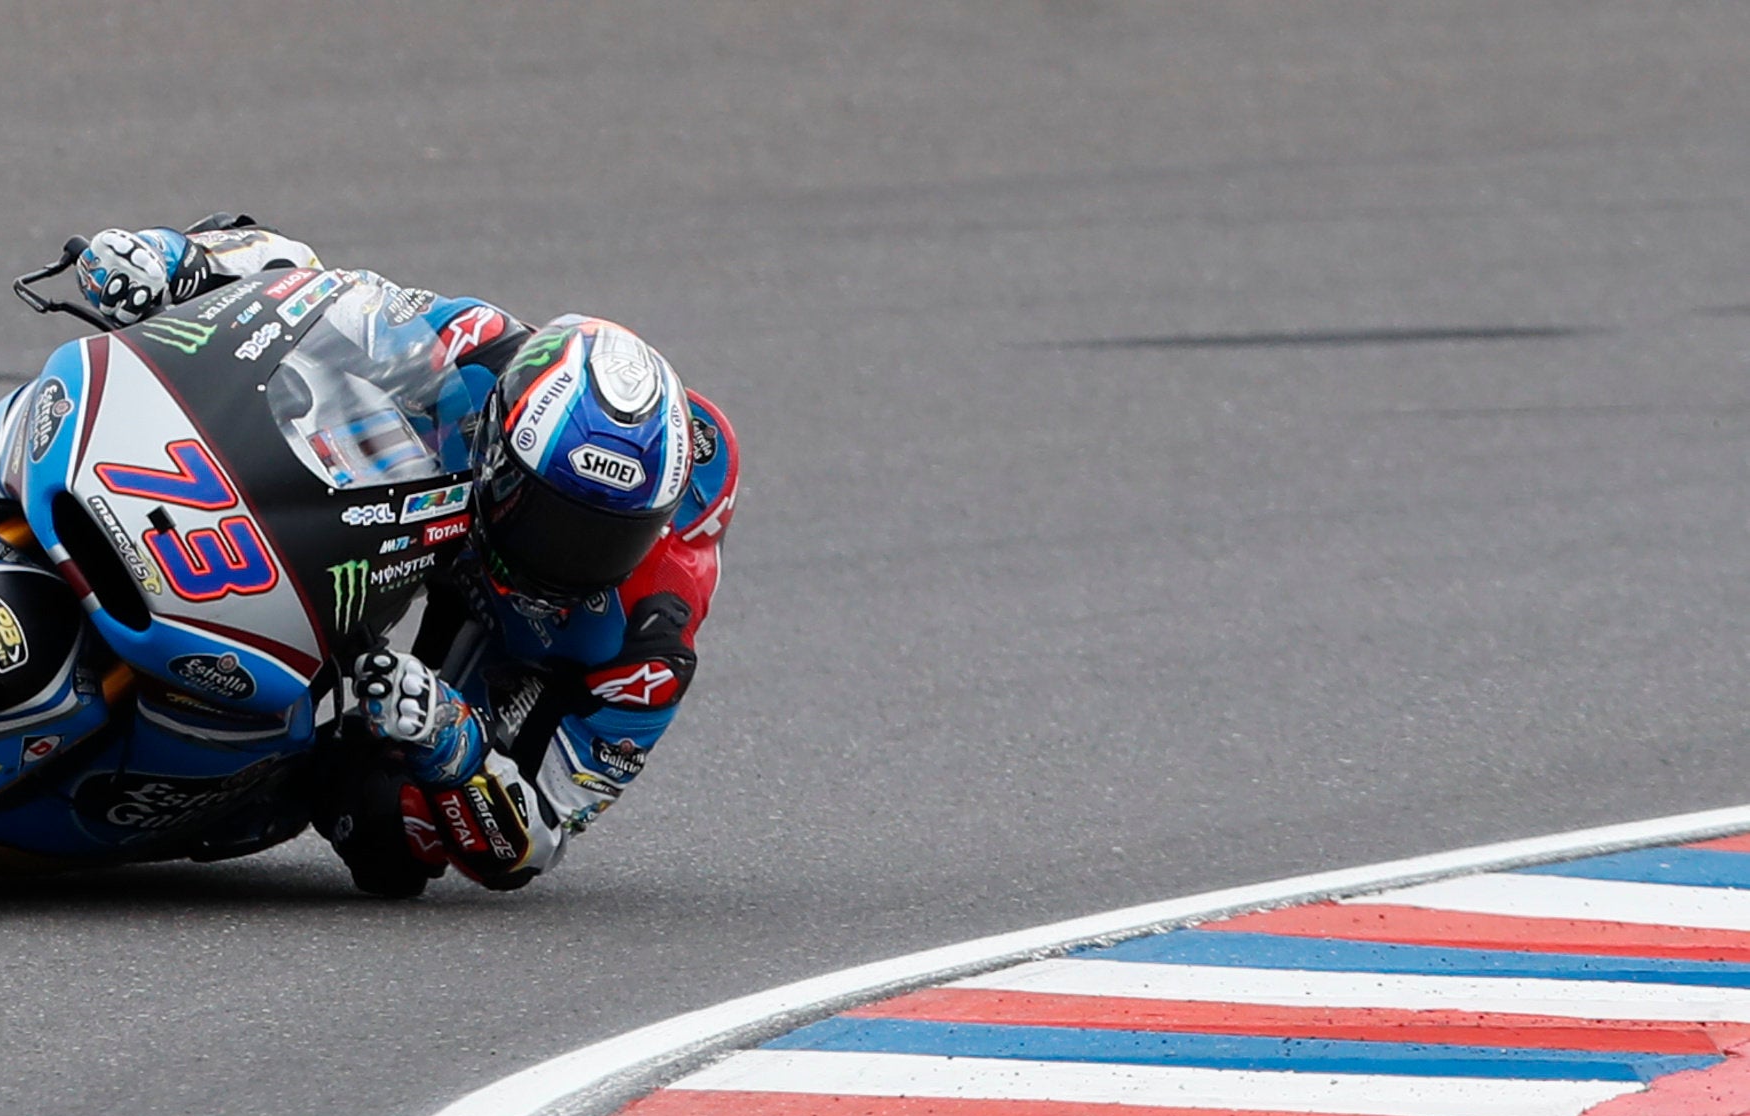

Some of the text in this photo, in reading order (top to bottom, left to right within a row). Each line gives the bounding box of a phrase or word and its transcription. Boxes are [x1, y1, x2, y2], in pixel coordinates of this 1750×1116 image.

[527, 370, 574, 427] Allianz
[581, 450, 638, 484] SHOEI
[94, 438, 280, 602] 73
[426, 522, 467, 542] TOTAL
[370, 552, 436, 585] MONSTER
[184, 657, 248, 694] Estrella
[441, 795, 477, 849] TOTAL
